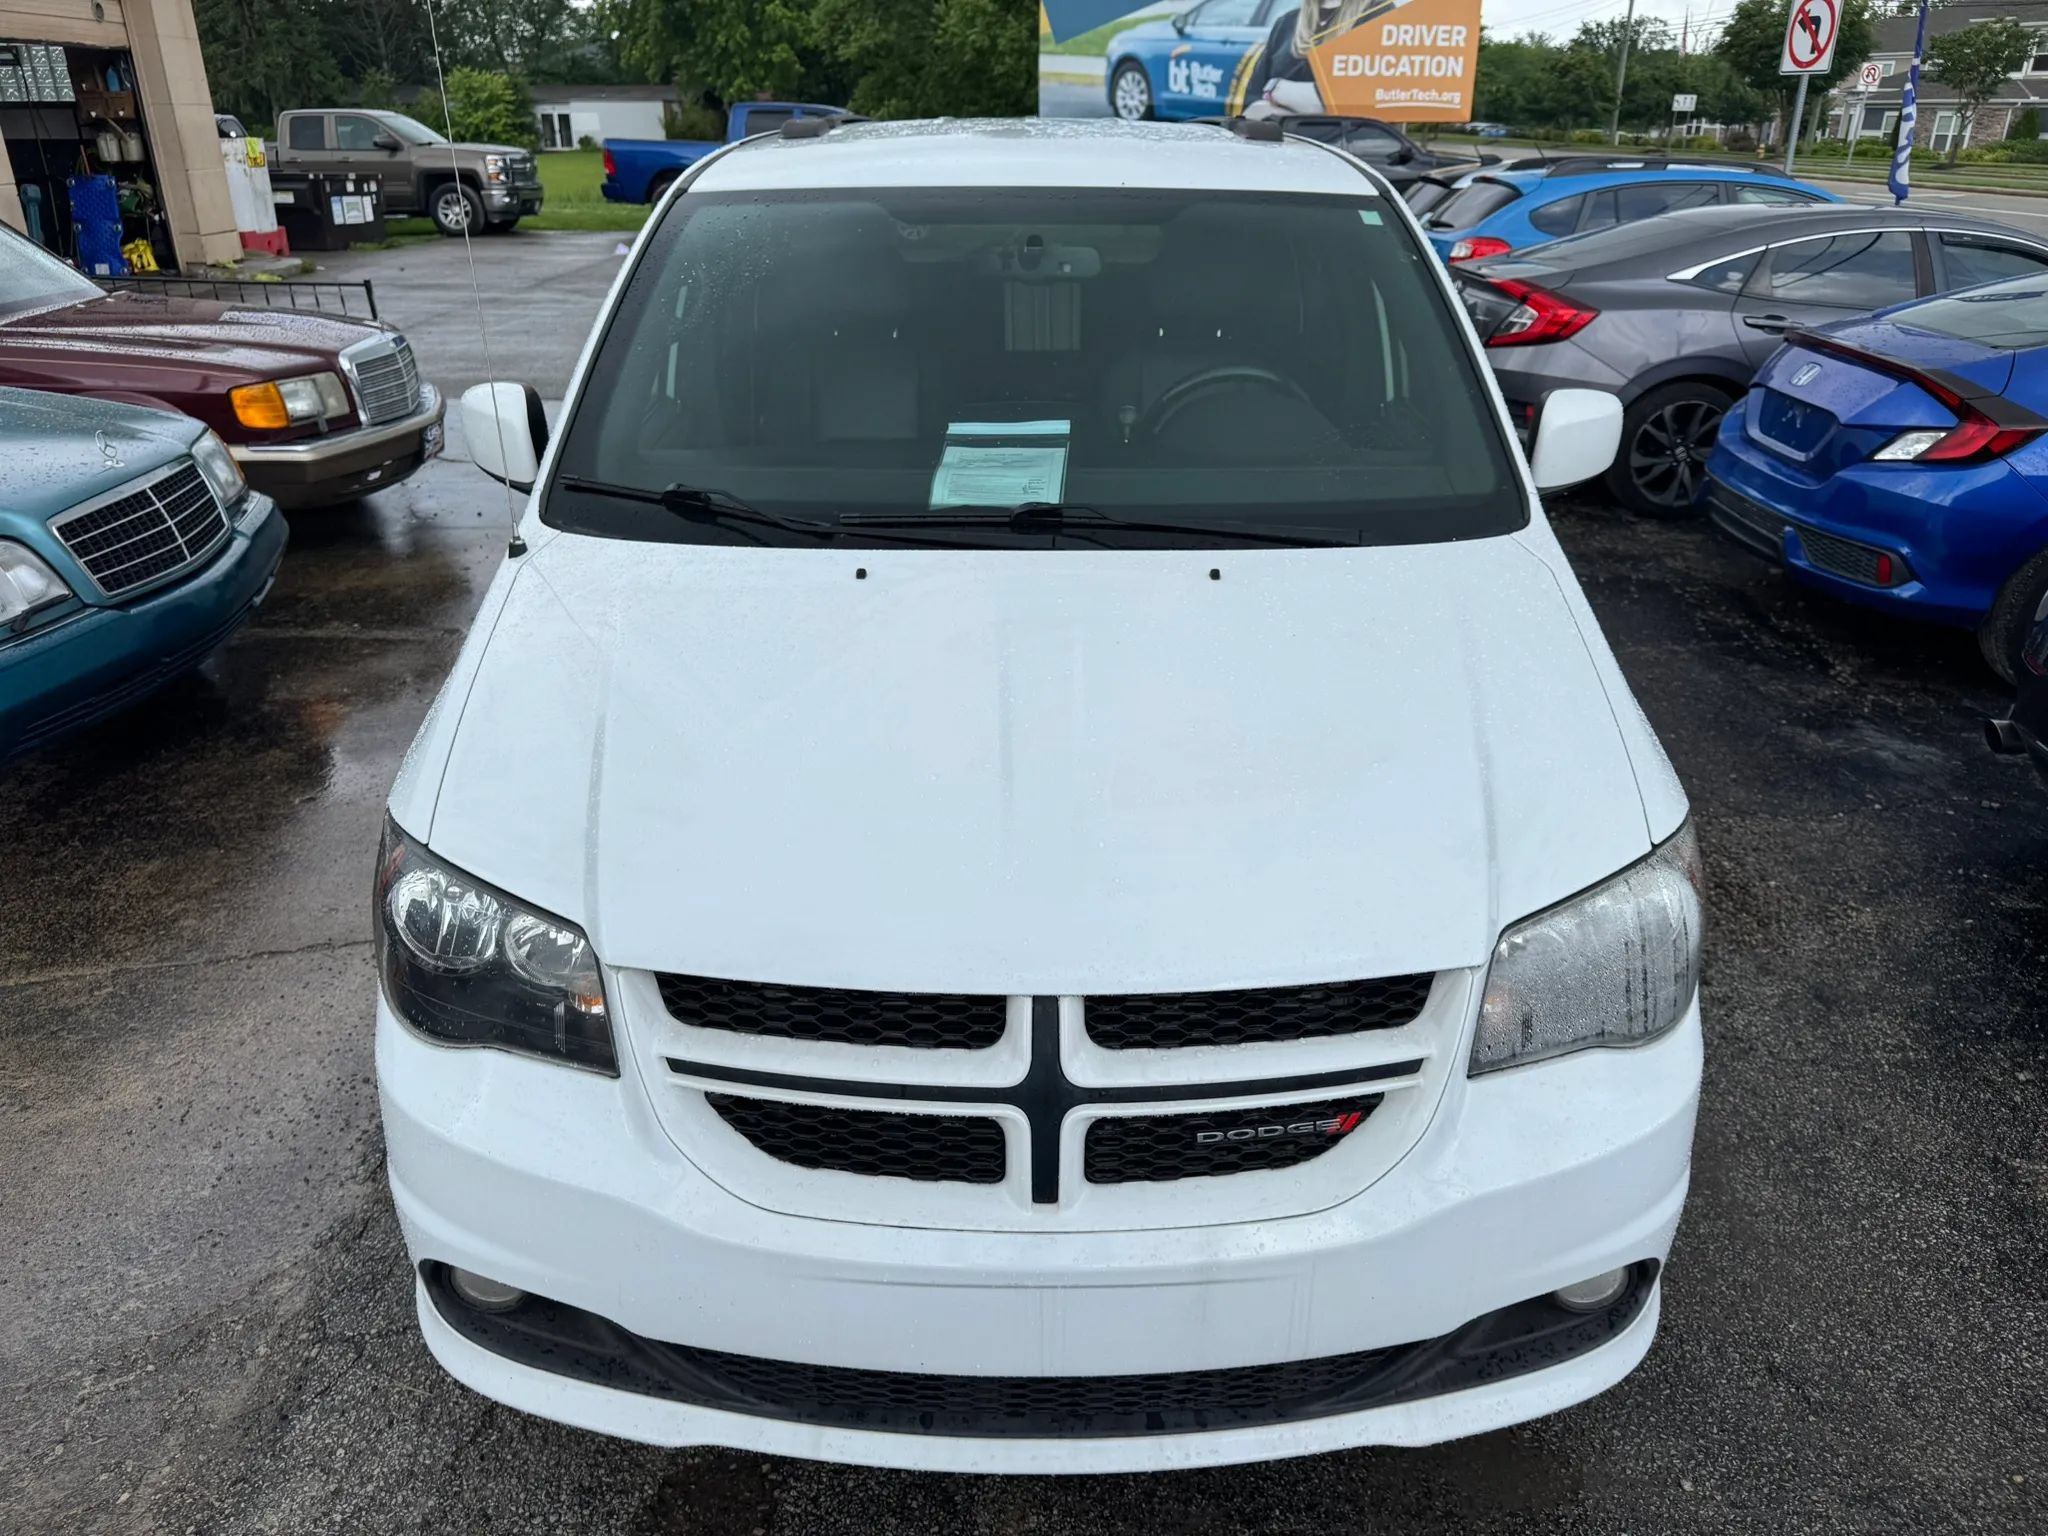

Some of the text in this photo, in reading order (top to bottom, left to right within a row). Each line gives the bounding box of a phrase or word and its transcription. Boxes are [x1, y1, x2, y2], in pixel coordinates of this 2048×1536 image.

[1381, 23, 1467, 47] DRIVER
[1332, 54, 1464, 78] EDUCATION
[1375, 88, 1461, 104] ButlerTech.org
[1196, 1118, 1341, 1143] DODGE
